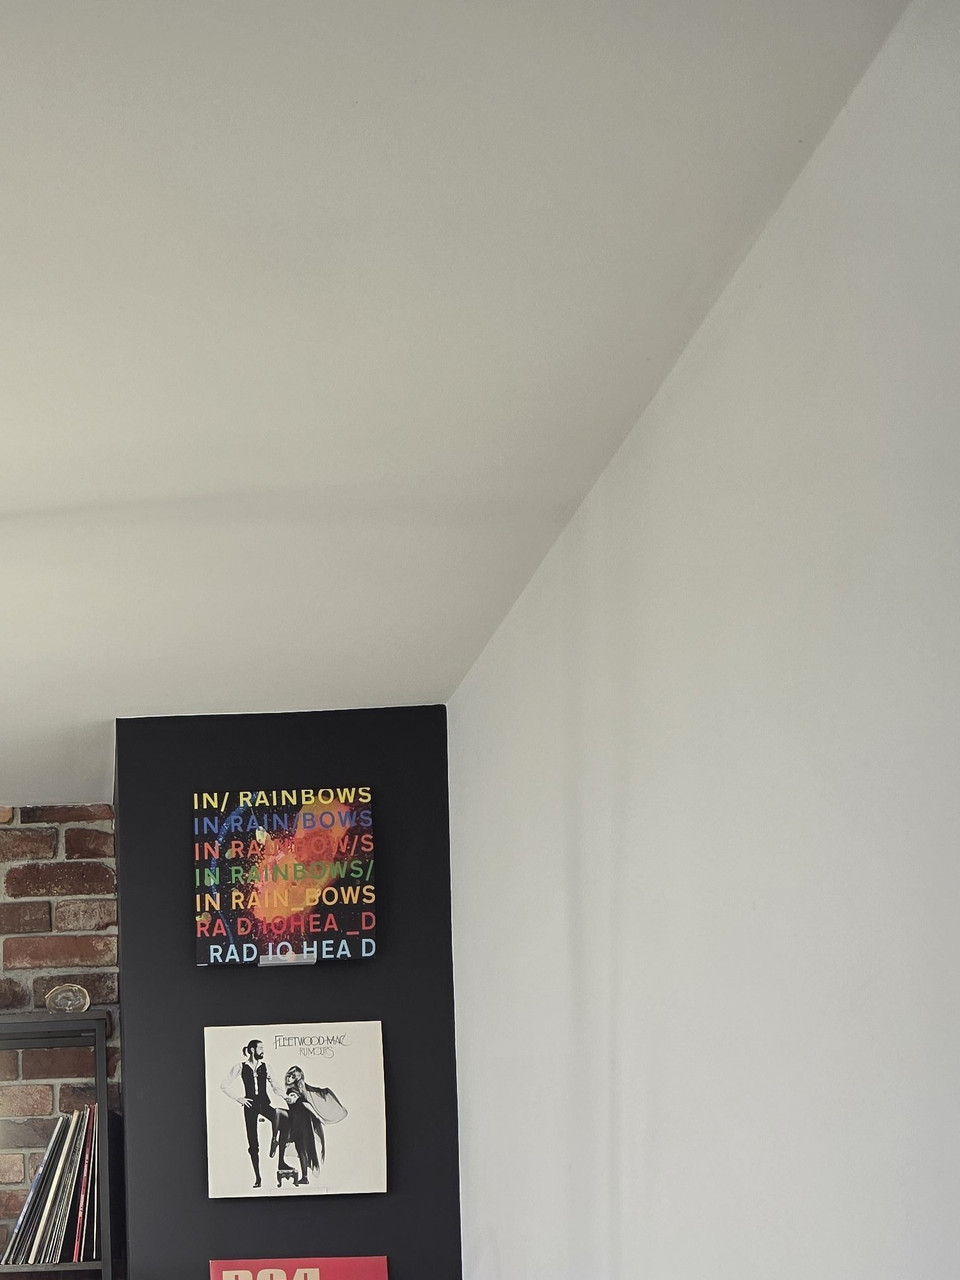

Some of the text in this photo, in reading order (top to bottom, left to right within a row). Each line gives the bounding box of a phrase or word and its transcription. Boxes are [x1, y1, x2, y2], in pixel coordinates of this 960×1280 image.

[193, 787, 372, 812] IN/ RAINBOWS
[194, 810, 373, 835] IN RAIN/BOWS
[195, 834, 374, 860] IN RAINBOW/S
[195, 860, 374, 886] IN RAINBOWS/
[196, 885, 376, 912] IN RAIN_BOWS
[299, 1047, 334, 1058] RUMOURS
